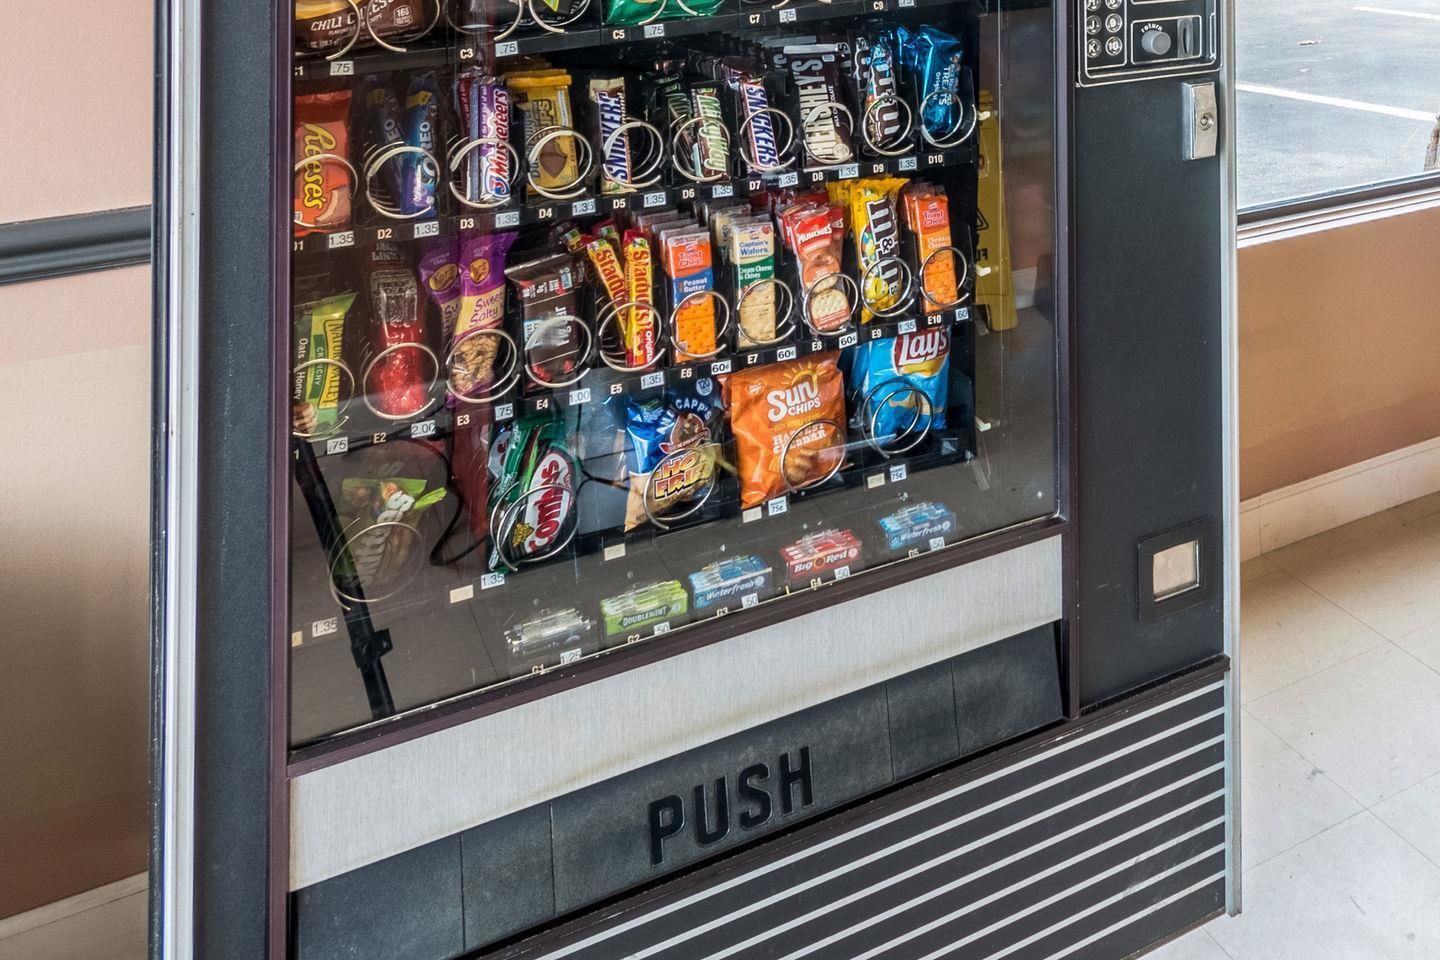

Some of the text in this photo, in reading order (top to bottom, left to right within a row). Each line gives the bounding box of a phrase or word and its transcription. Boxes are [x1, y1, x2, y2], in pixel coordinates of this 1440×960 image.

[873, 0, 884, 10] C9
[749, 14, 760, 24] C7
[781, 10, 795, 20] .75
[310, 17, 342, 32] CHILI
[1088, 20, 1096, 29] J
[1141, 22, 1163, 33] return
[612, 29, 626, 40] C5
[499, 43, 517, 54] .75
[1088, 43, 1096, 53] K
[1108, 41, 1119, 50] 10
[460, 48, 474, 59] C3
[332, 63, 351, 73] .75
[928, 154, 943, 164] D10
[303, 123, 337, 209] Reese's
[873, 163, 884, 173] D9
[812, 172, 824, 181] D8
[749, 180, 761, 190] D7
[645, 194, 665, 205] 1.35
[682, 189, 695, 199] D6
[573, 200, 595, 212] 1.35
[612, 198, 626, 209] D5
[538, 208, 553, 218] D4
[460, 218, 474, 229] D3
[497, 213, 520, 225] 1.35
[377, 228, 393, 239] D2
[415, 223, 439, 235] 1.35
[329, 232, 354, 246] 1.35
[797, 226, 832, 245] MUNCHIES
[683, 277, 708, 287] Peanut
[683, 284, 706, 293] Butter
[927, 314, 942, 325] E10
[871, 329, 882, 339] E9
[812, 341, 823, 351] E8
[747, 353, 758, 365] E7
[294, 338, 308, 400] Oats Honey
[680, 368, 693, 379] E6
[610, 383, 623, 395] E5
[536, 398, 549, 410] E4
[767, 381, 819, 422] Sun
[787, 397, 822, 416] CHIPS
[496, 405, 513, 418] .75
[675, 398, 713, 420] CAPP'S
[457, 414, 470, 426] E3
[411, 422, 436, 436] 2.00
[373, 432, 387, 444] E2
[328, 439, 347, 452] .75
[794, 550, 848, 574] Big Red
[481, 575, 504, 588] 1.35
[706, 581, 754, 601] Winterfresh
[622, 606, 667, 627] DOUBLEMINT
[313, 619, 338, 634] 1.35
[648, 745, 815, 867] PUSH
